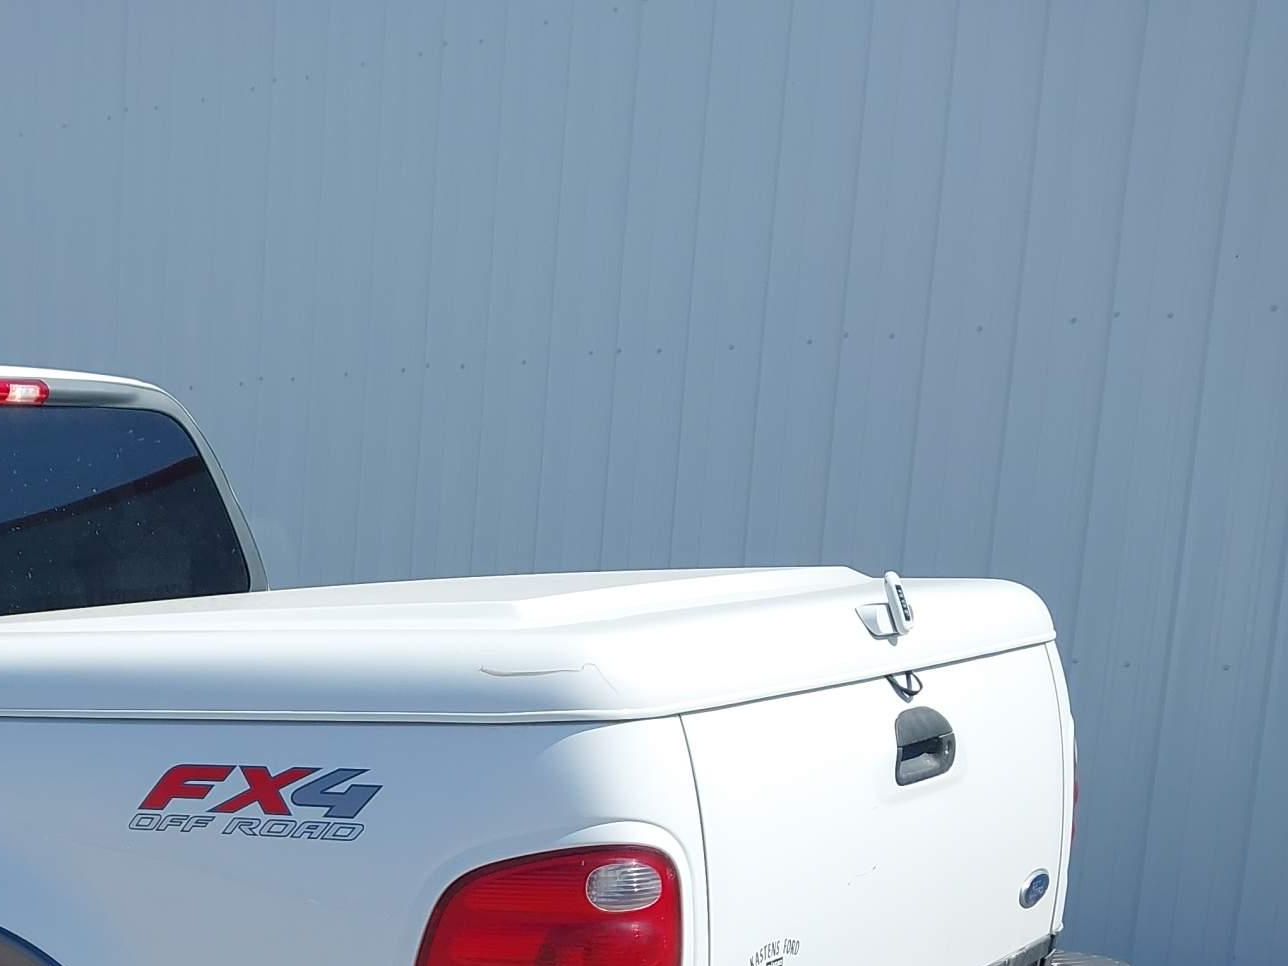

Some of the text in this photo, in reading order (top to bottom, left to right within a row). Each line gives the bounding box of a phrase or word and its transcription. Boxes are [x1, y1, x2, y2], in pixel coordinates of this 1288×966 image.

[137, 764, 383, 819] FX4
[128, 813, 365, 842] OFF ROAD
[783, 938, 800, 956] FORD
